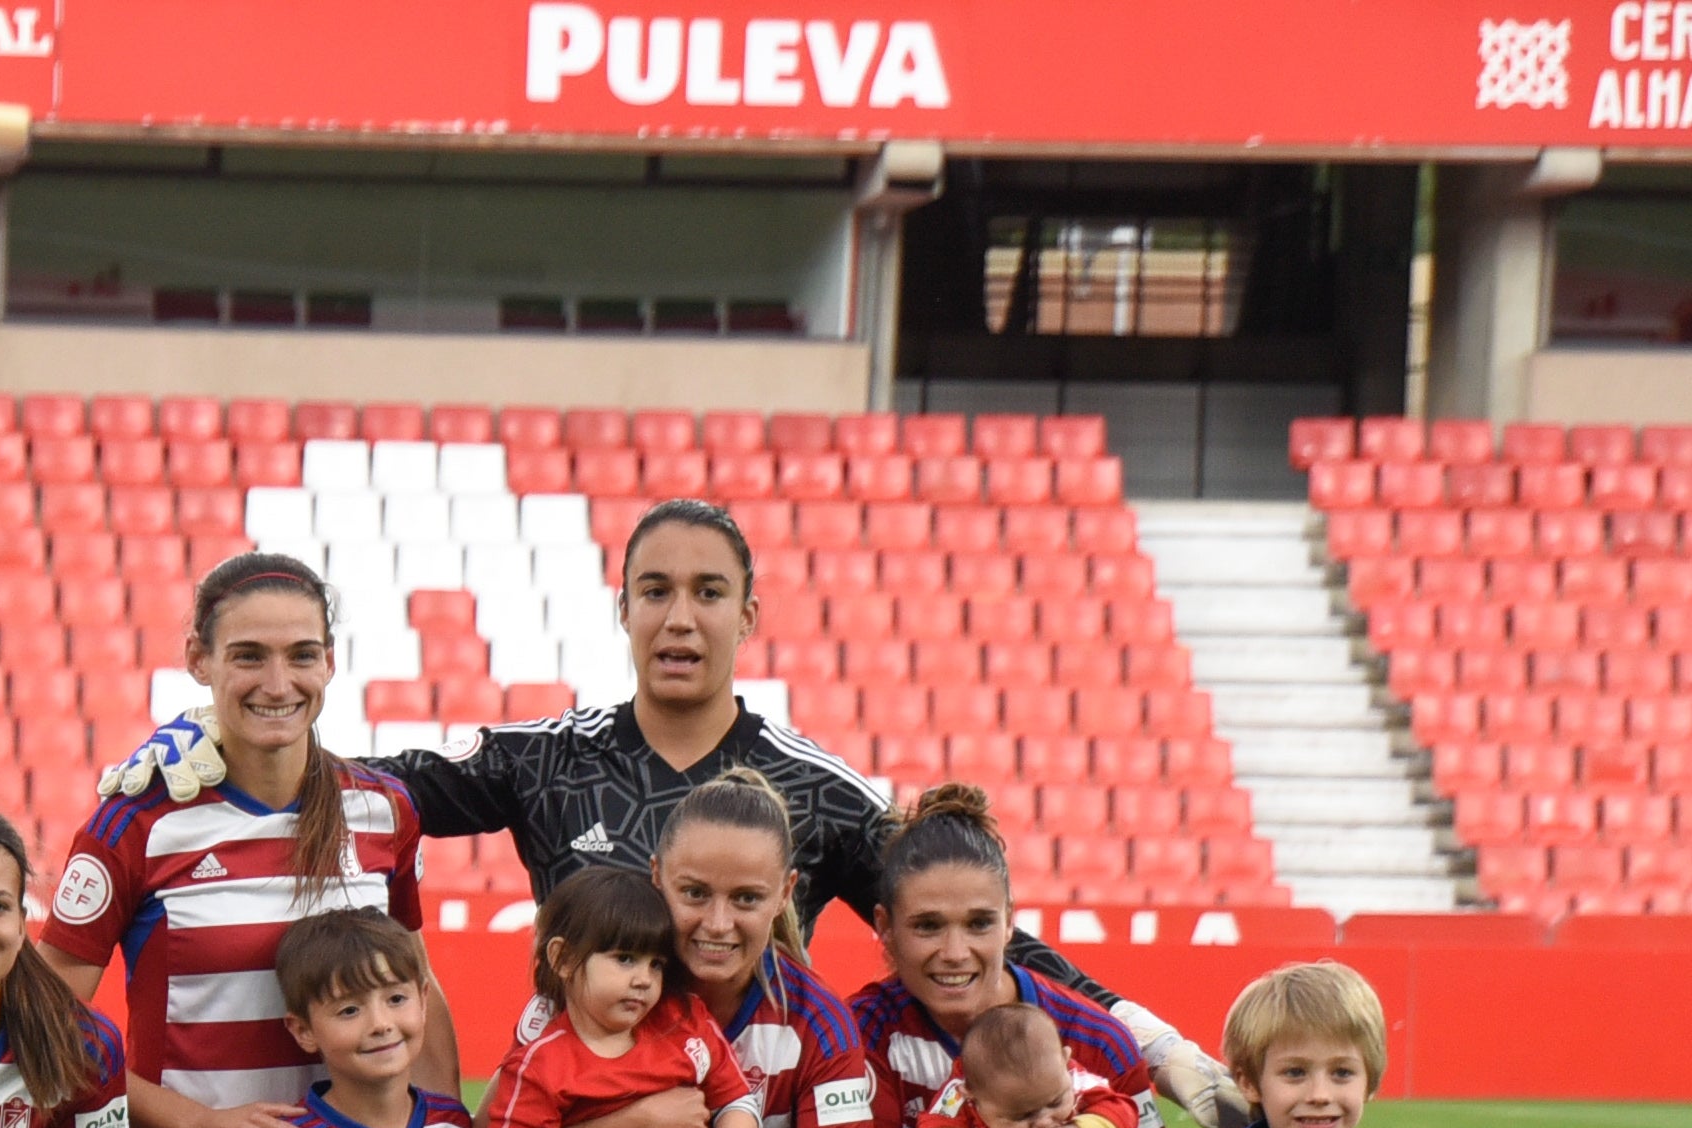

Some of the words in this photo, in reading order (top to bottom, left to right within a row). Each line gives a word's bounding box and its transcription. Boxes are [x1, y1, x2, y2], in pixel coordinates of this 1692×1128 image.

[526, 2, 950, 109] PULEVA
[570, 840, 614, 853] adidas
[191, 866, 228, 879] adidas
